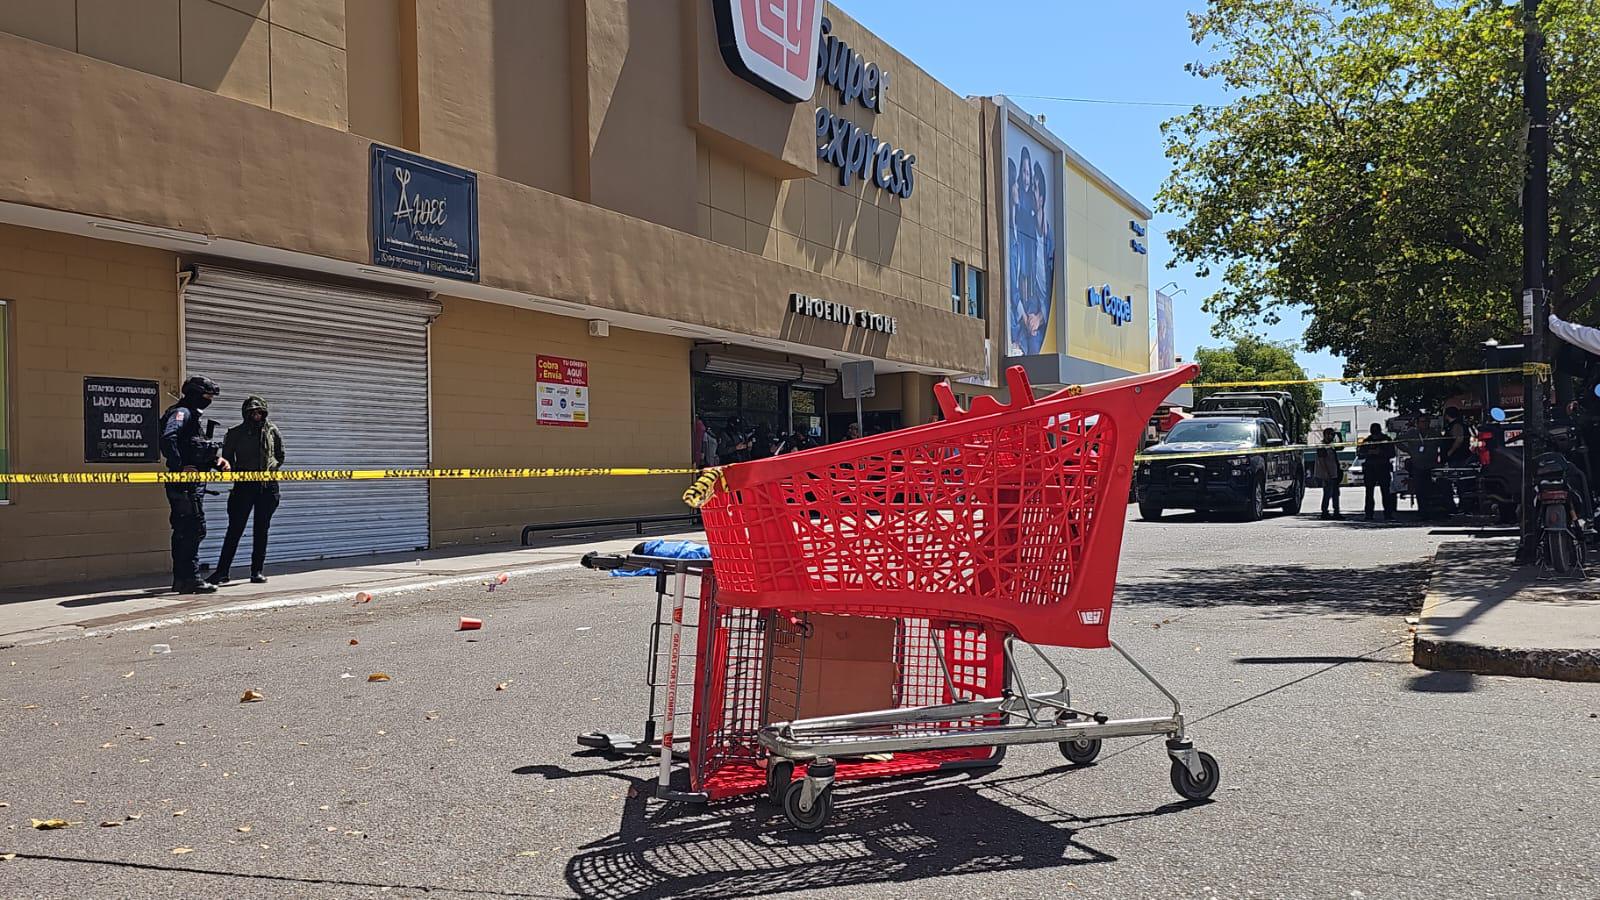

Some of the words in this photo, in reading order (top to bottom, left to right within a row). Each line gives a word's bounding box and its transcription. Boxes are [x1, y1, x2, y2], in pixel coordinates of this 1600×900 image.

[815, 106, 916, 199] express
[1101, 284, 1132, 326] Coppel
[792, 292, 855, 326] PHOENIX
[858, 310, 897, 335] STORE
[538, 359, 558, 369] Cobra
[87, 384, 114, 392] ESTAMOS
[115, 386, 156, 394] CONTRATANDO
[93, 396, 117, 406] LADY
[119, 398, 152, 408] BARBER
[103, 413, 143, 424] BARBERO
[101, 429, 142, 439] ESTILISTA
[672, 633, 680, 663] GRACIAS
